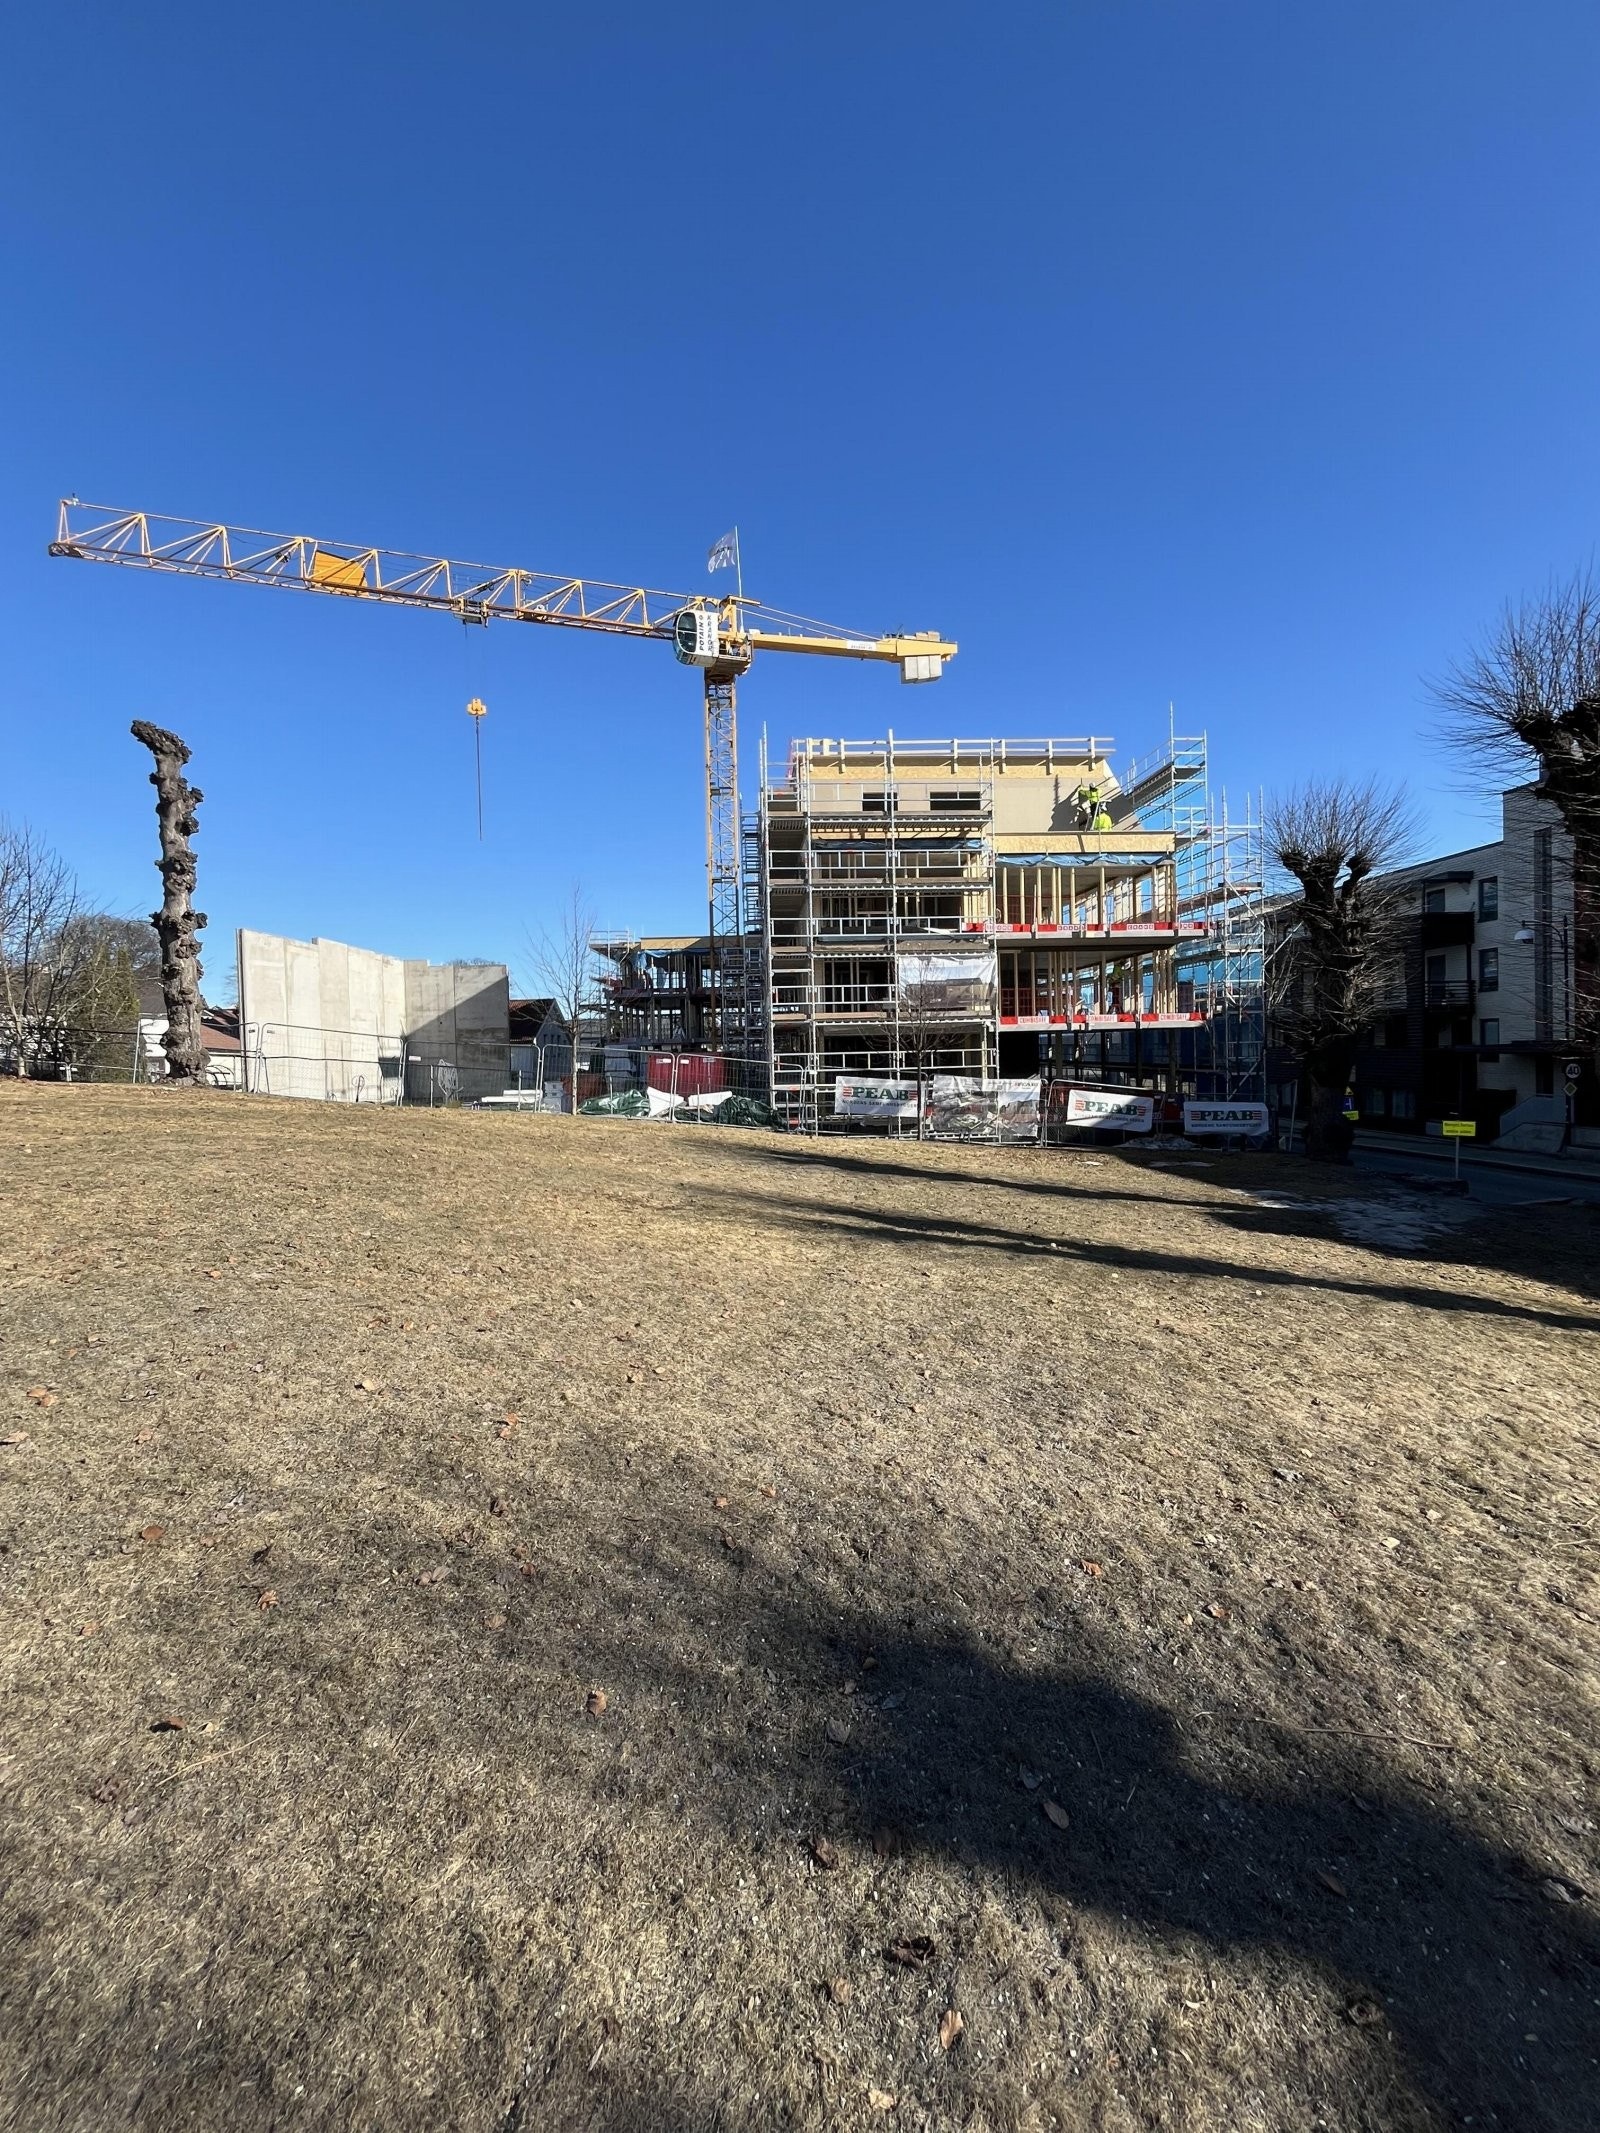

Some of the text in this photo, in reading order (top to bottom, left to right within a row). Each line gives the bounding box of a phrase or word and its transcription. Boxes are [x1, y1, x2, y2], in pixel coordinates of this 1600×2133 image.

[1568, 1066, 1580, 1075] 40
[851, 1086, 909, 1100] PEAB
[1083, 1101, 1138, 1115] PEAB
[1200, 1110, 1254, 1120] PEAB
